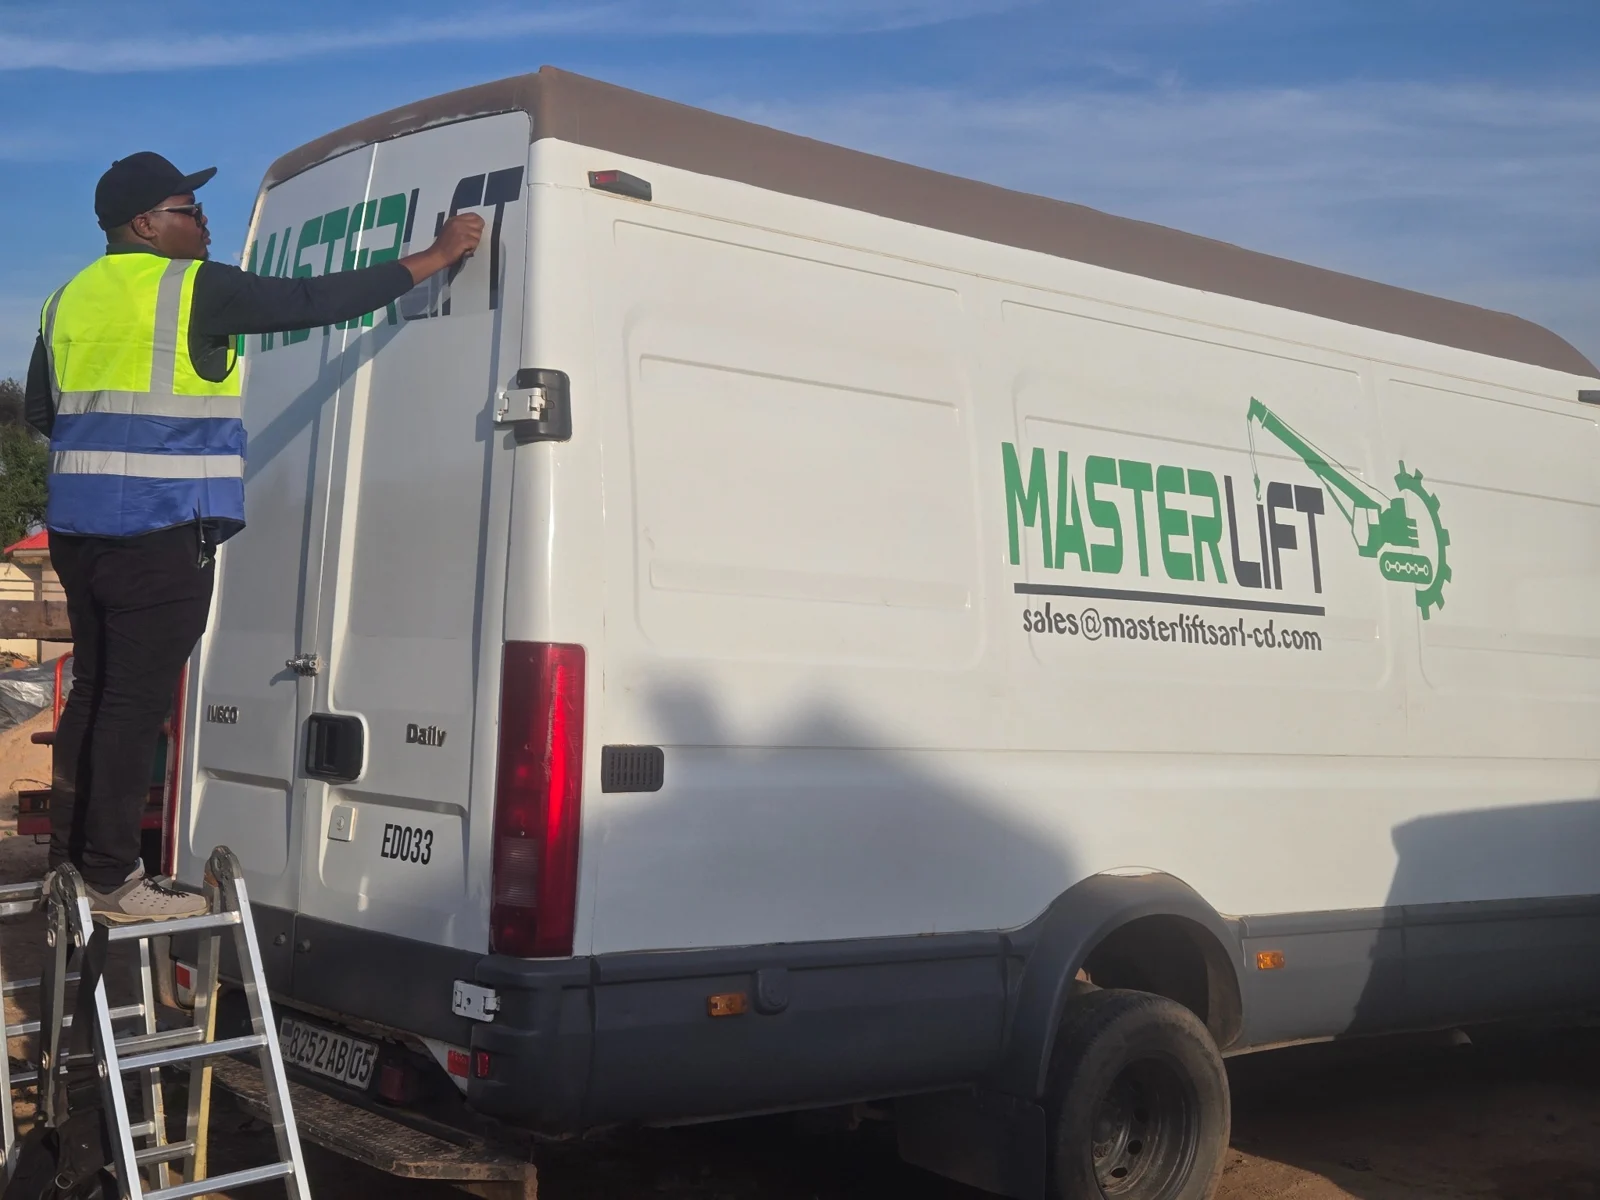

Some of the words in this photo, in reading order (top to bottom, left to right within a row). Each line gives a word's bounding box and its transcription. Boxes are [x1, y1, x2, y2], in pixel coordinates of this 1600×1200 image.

[1022, 601, 1323, 651] sales@masterliftsarl-cd.com
[206, 704, 239, 724] IVECO
[406, 723, 447, 747] Daily
